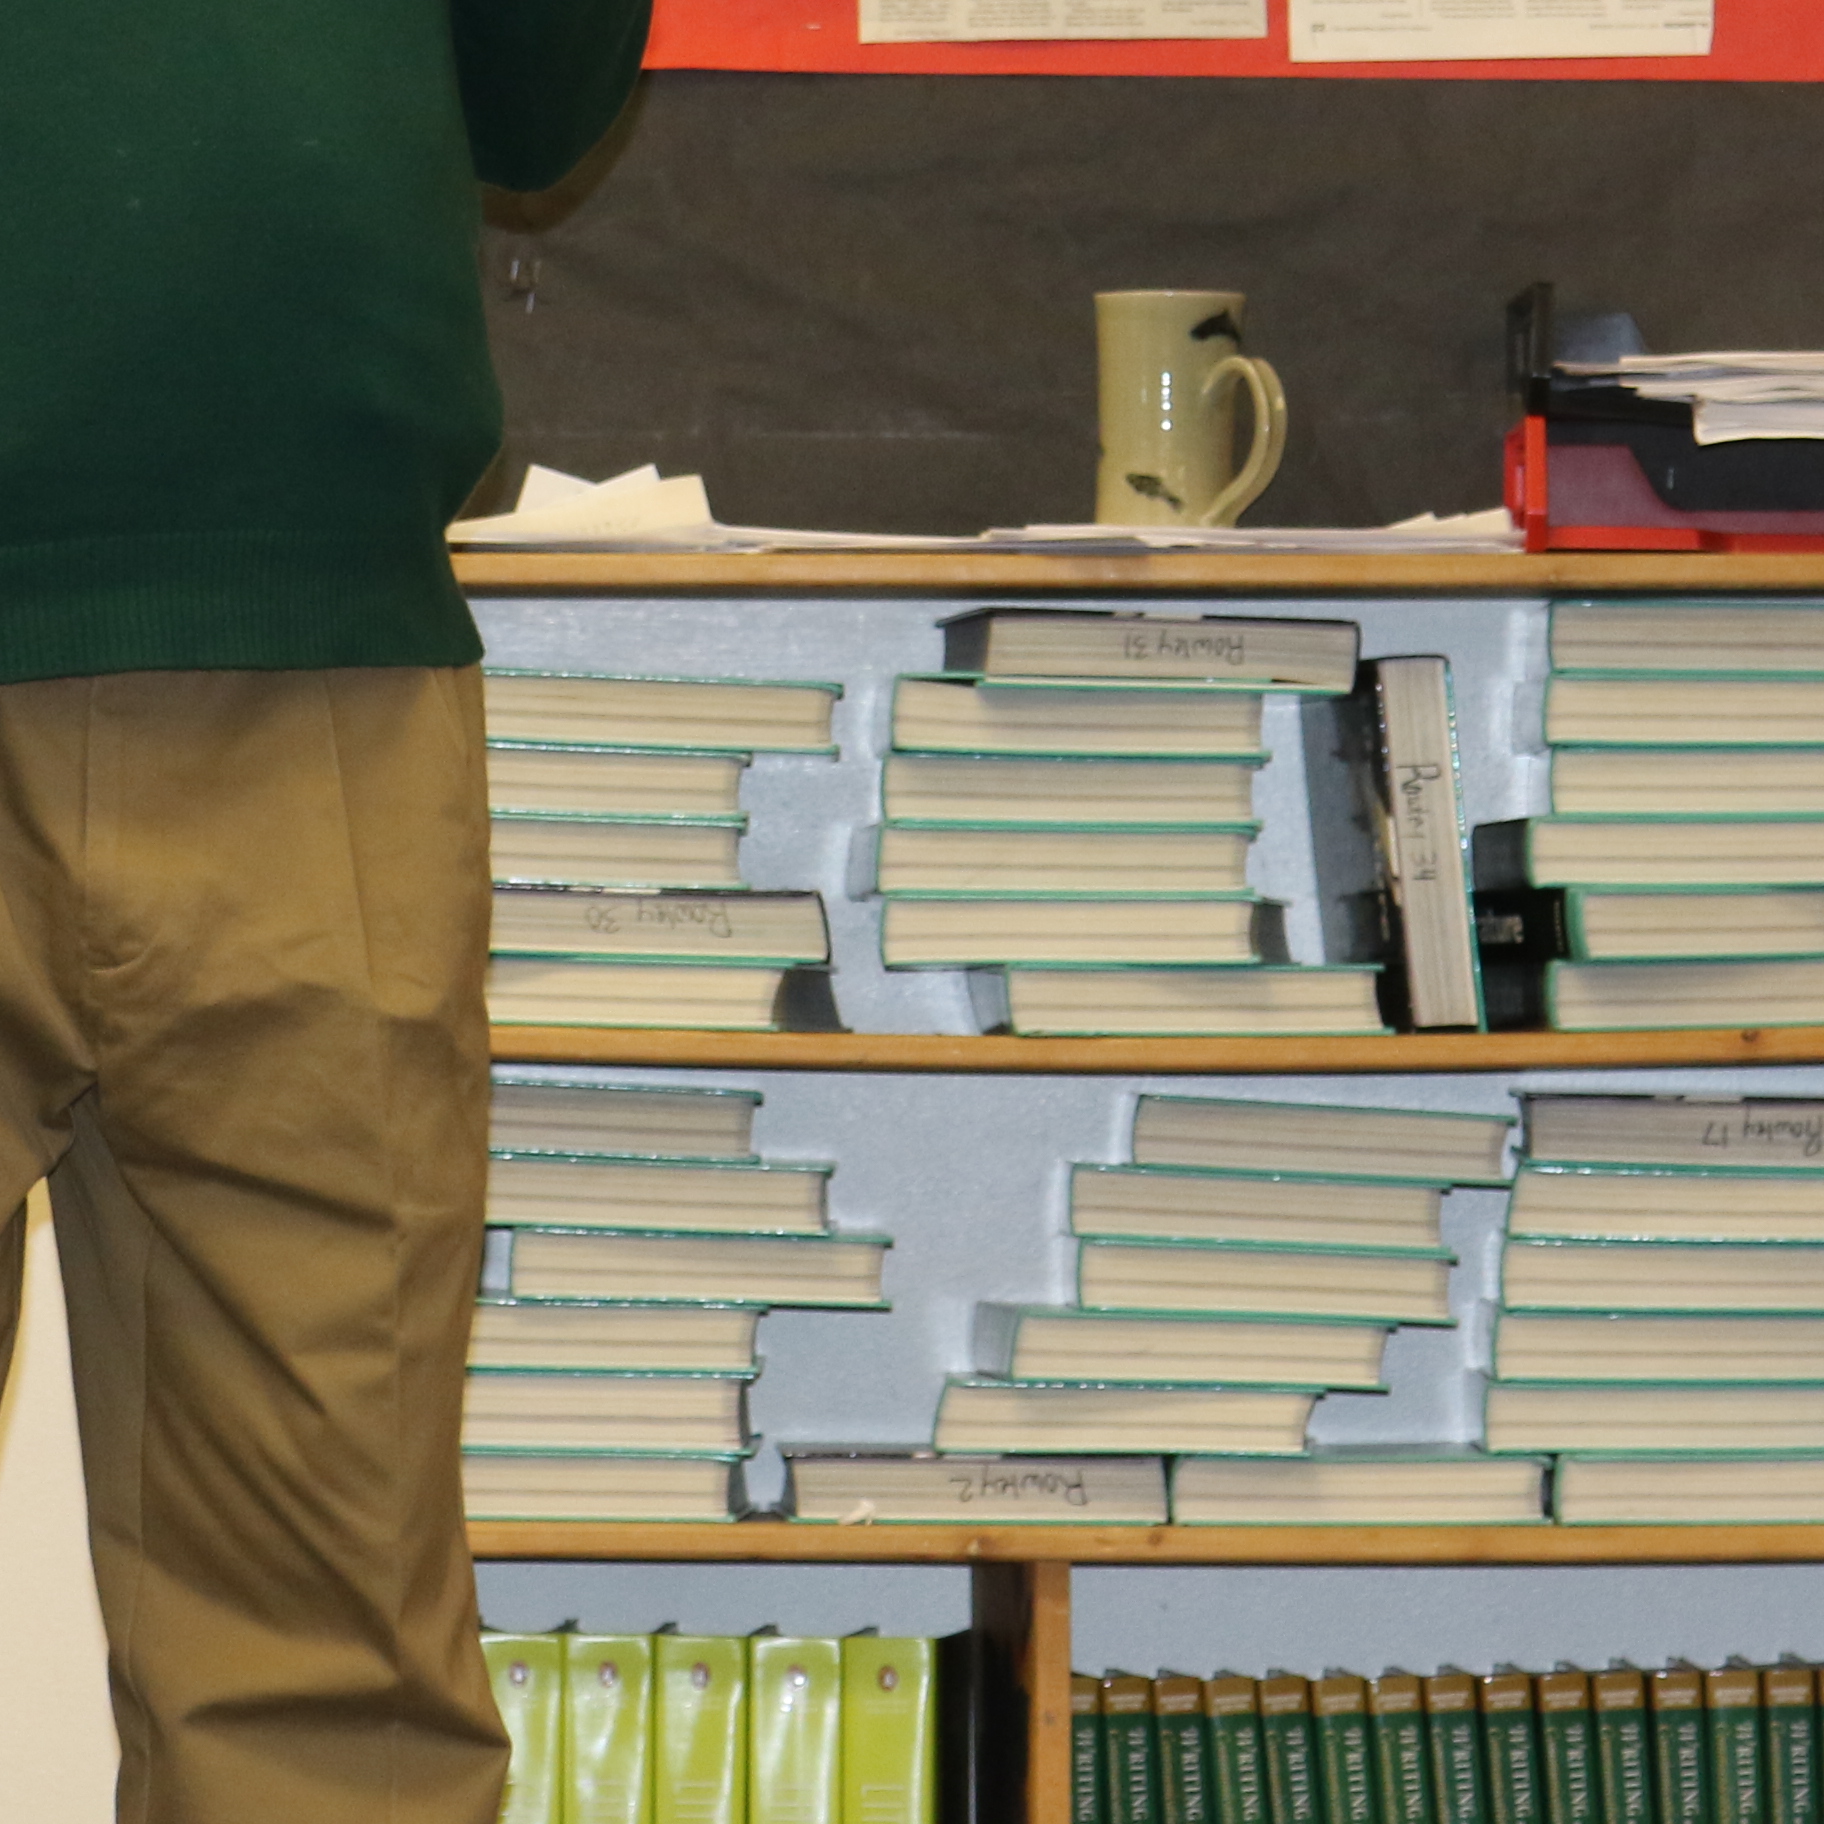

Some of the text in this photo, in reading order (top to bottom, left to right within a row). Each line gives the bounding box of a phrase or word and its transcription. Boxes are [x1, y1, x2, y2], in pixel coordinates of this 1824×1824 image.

[1076, 1727, 1097, 1822] WRITING
[1127, 1726, 1148, 1822] WRITING
[1179, 1726, 1204, 1822] WRITING
[1235, 1726, 1260, 1822] WRITING
[1285, 1726, 1312, 1821] WRITING
[1343, 1726, 1367, 1821] WRITING
[1398, 1725, 1424, 1820] WRITING
[1452, 1724, 1475, 1820] WRITING
[1508, 1724, 1531, 1819] WRITING
[1565, 1724, 1589, 1819] WRITING
[1620, 1723, 1644, 1818] WRITING
[1677, 1722, 1700, 1817] WRITING
[1735, 1720, 1757, 1815] WRITING
[1790, 1720, 1811, 1814] WRITING
